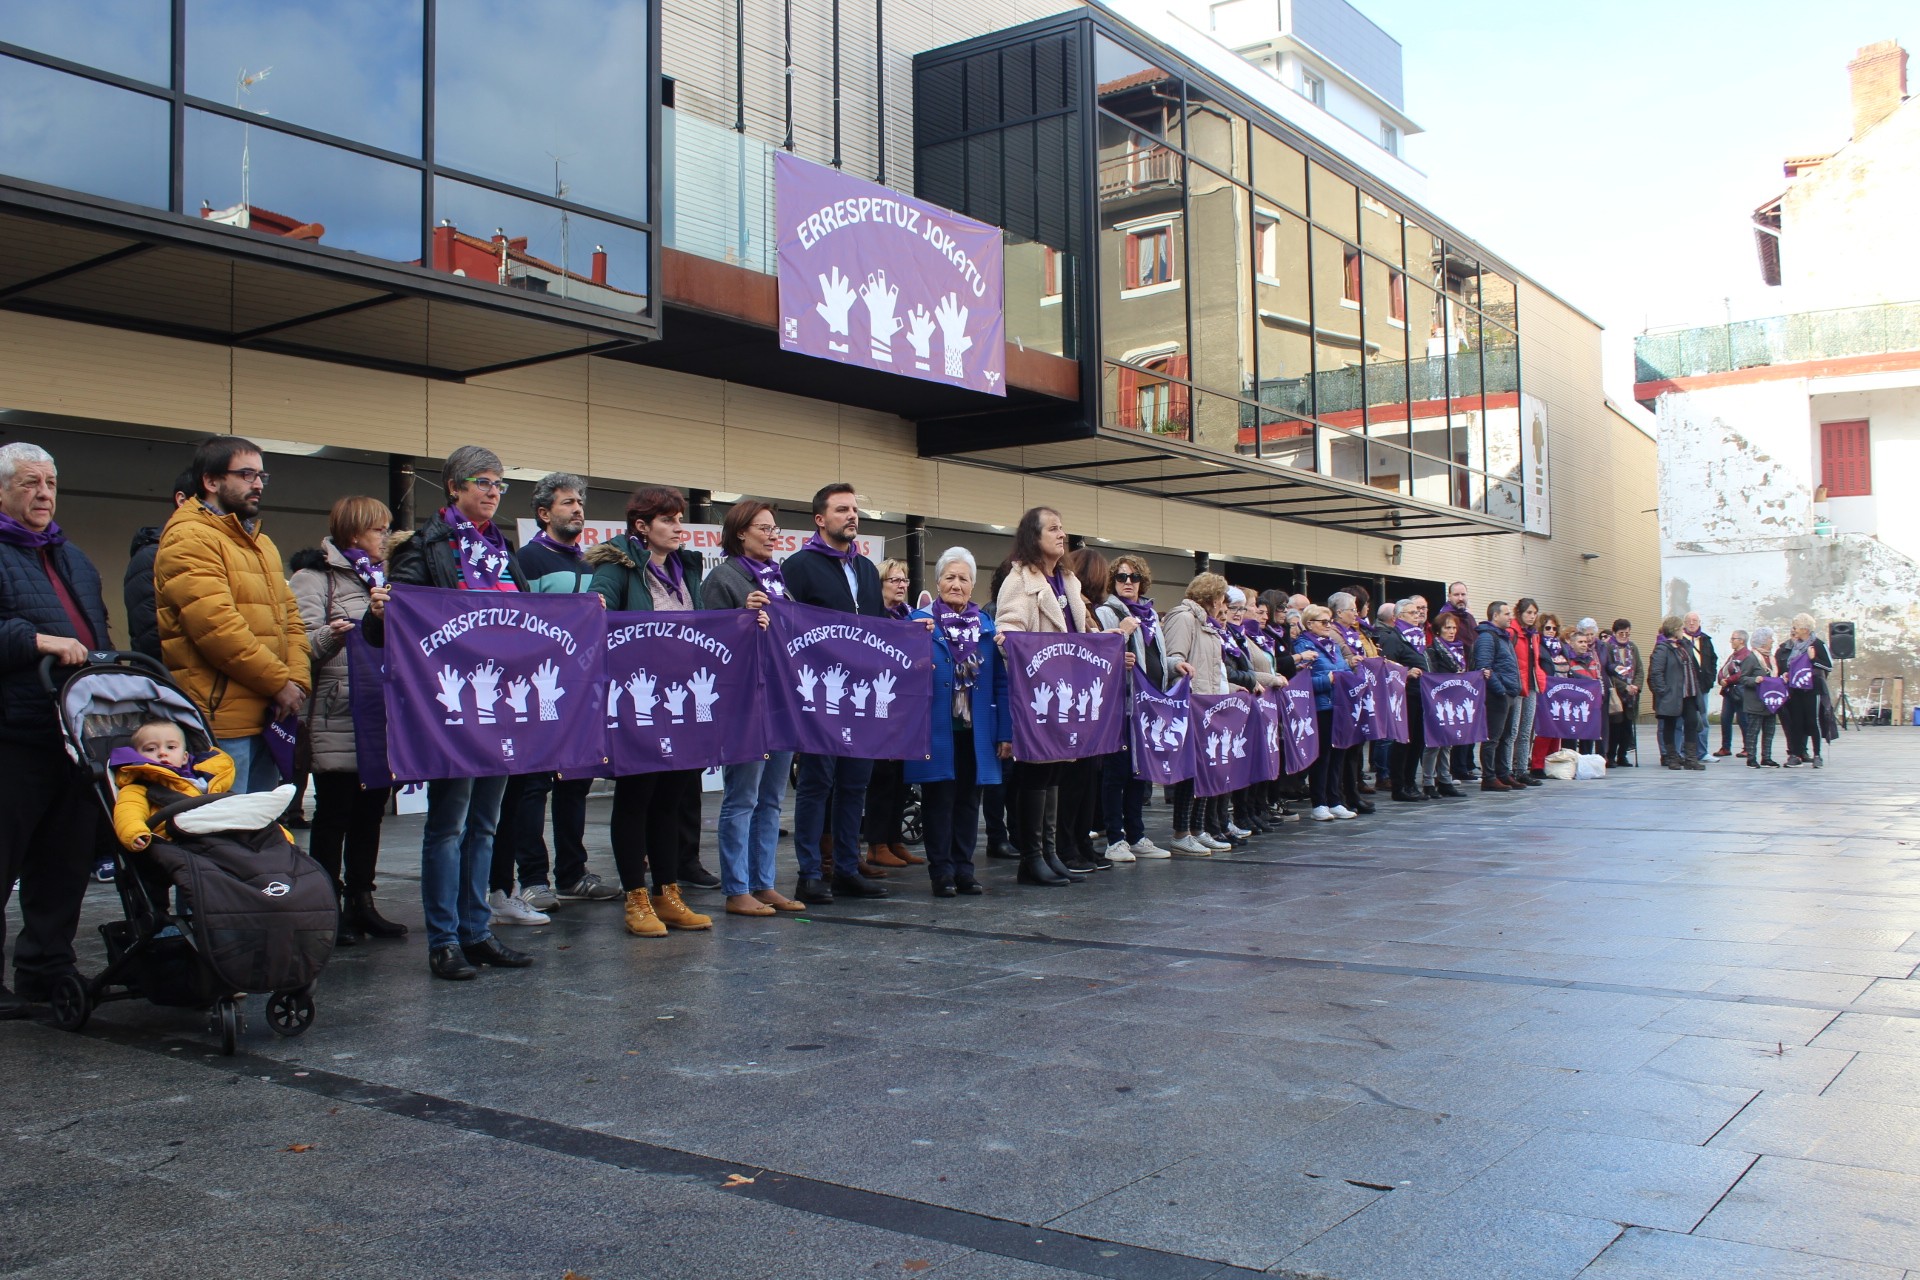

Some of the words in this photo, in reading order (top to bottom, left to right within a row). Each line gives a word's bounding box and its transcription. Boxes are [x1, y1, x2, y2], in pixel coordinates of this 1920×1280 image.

[797, 197, 921, 251] ERRESPETUZ
[923, 218, 986, 298] JOKATU
[419, 608, 520, 657] ERRESPETUZ
[520, 612, 577, 656] JOKATU
[607, 622, 677, 651] ESPETUZ
[677, 625, 732, 665] JOKATU
[786, 625, 863, 658] ERRESPETUZ
[862, 631, 912, 670] JOKATU
[1025, 643, 1076, 678] ERRESPETUZ
[1076, 645, 1113, 675] JOKATU
